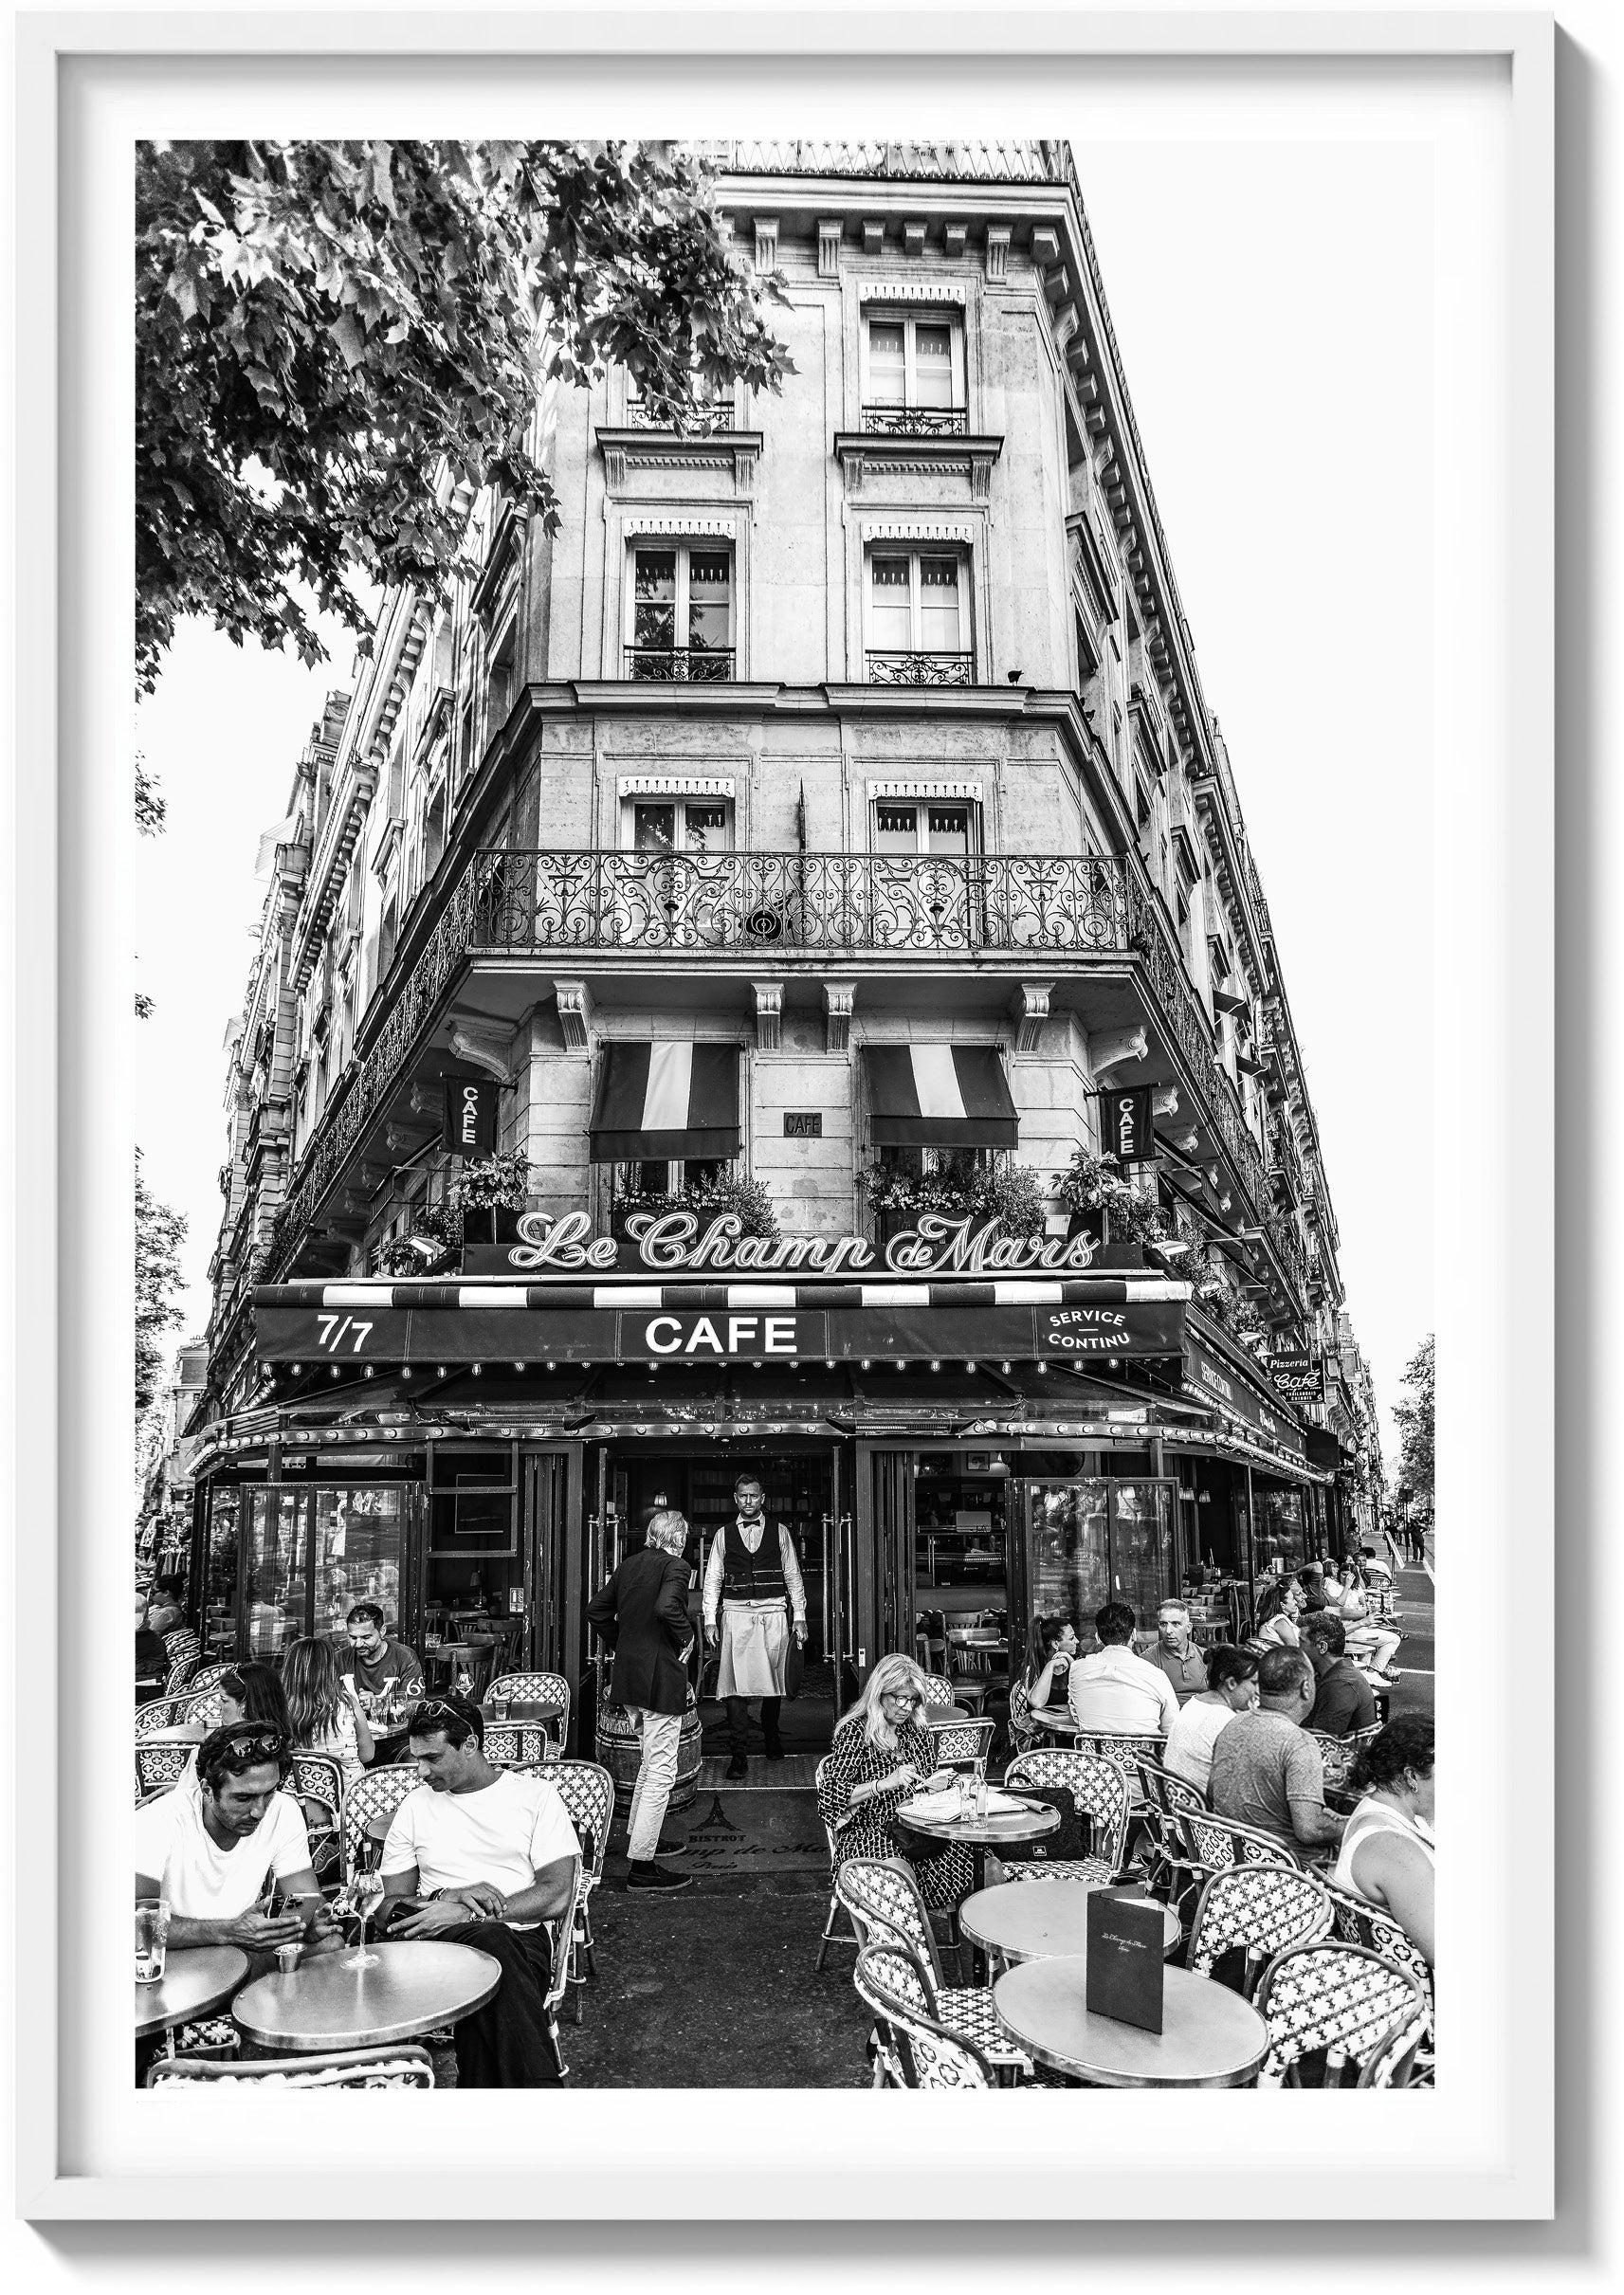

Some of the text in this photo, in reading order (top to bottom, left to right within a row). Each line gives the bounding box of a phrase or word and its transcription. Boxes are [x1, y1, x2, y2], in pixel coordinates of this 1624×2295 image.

[462, 1086, 479, 1144] CAFE
[785, 1115, 821, 1134] CAFE
[1119, 1098, 1135, 1155] CAFE
[508, 1211, 1101, 1273] Le Champ de Mars
[1049, 1310, 1126, 1327] SERVICE
[317, 1314, 374, 1353] 7/7
[645, 1316, 798, 1354] CAFE
[1048, 1332, 1131, 1349] CONTINU
[1270, 1358, 1308, 1369] Pizzeria
[1273, 1368, 1321, 1388] Café
[688, 1833, 747, 1843] BISTROT
